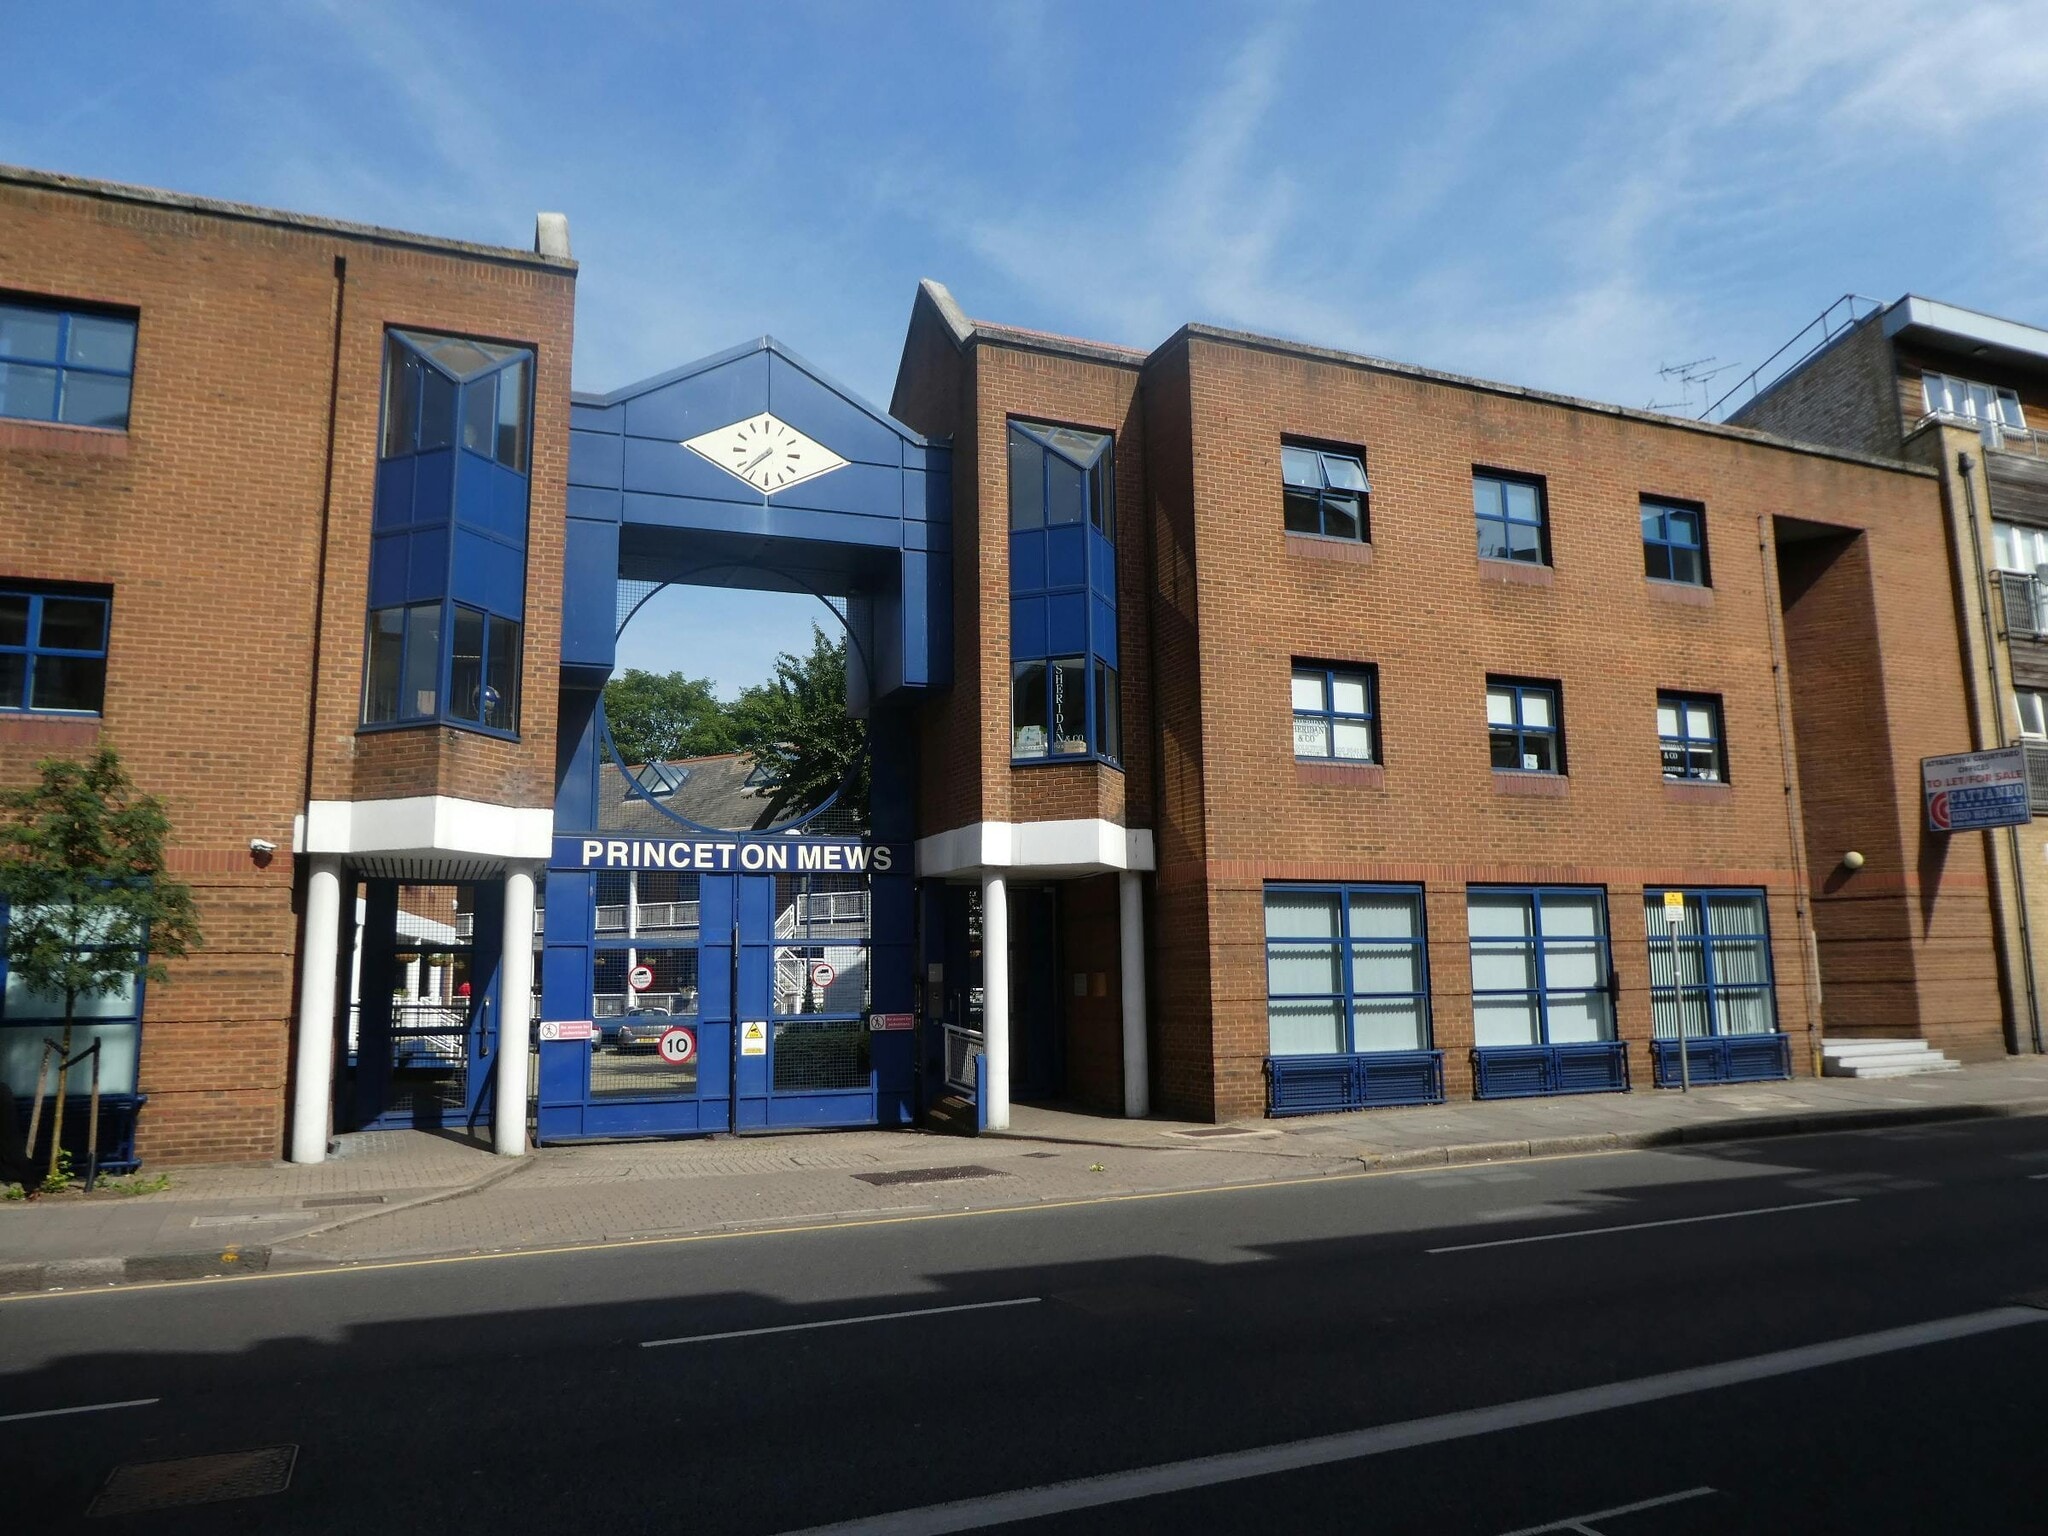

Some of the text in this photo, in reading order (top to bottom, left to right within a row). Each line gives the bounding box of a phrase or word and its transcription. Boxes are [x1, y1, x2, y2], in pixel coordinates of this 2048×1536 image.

[1055, 665, 1064, 742] SHERIDAN
[1305, 735, 1316, 743] CO
[1973, 750, 2020, 762] COURTYARD
[1958, 763, 1990, 773] OFFICES
[1927, 780, 1942, 788] TO
[1995, 770, 2023, 781] SALE
[1950, 784, 2024, 803] CATTANEO
[582, 840, 893, 871] PRINCETON MEWS
[667, 1038, 688, 1053] 10
